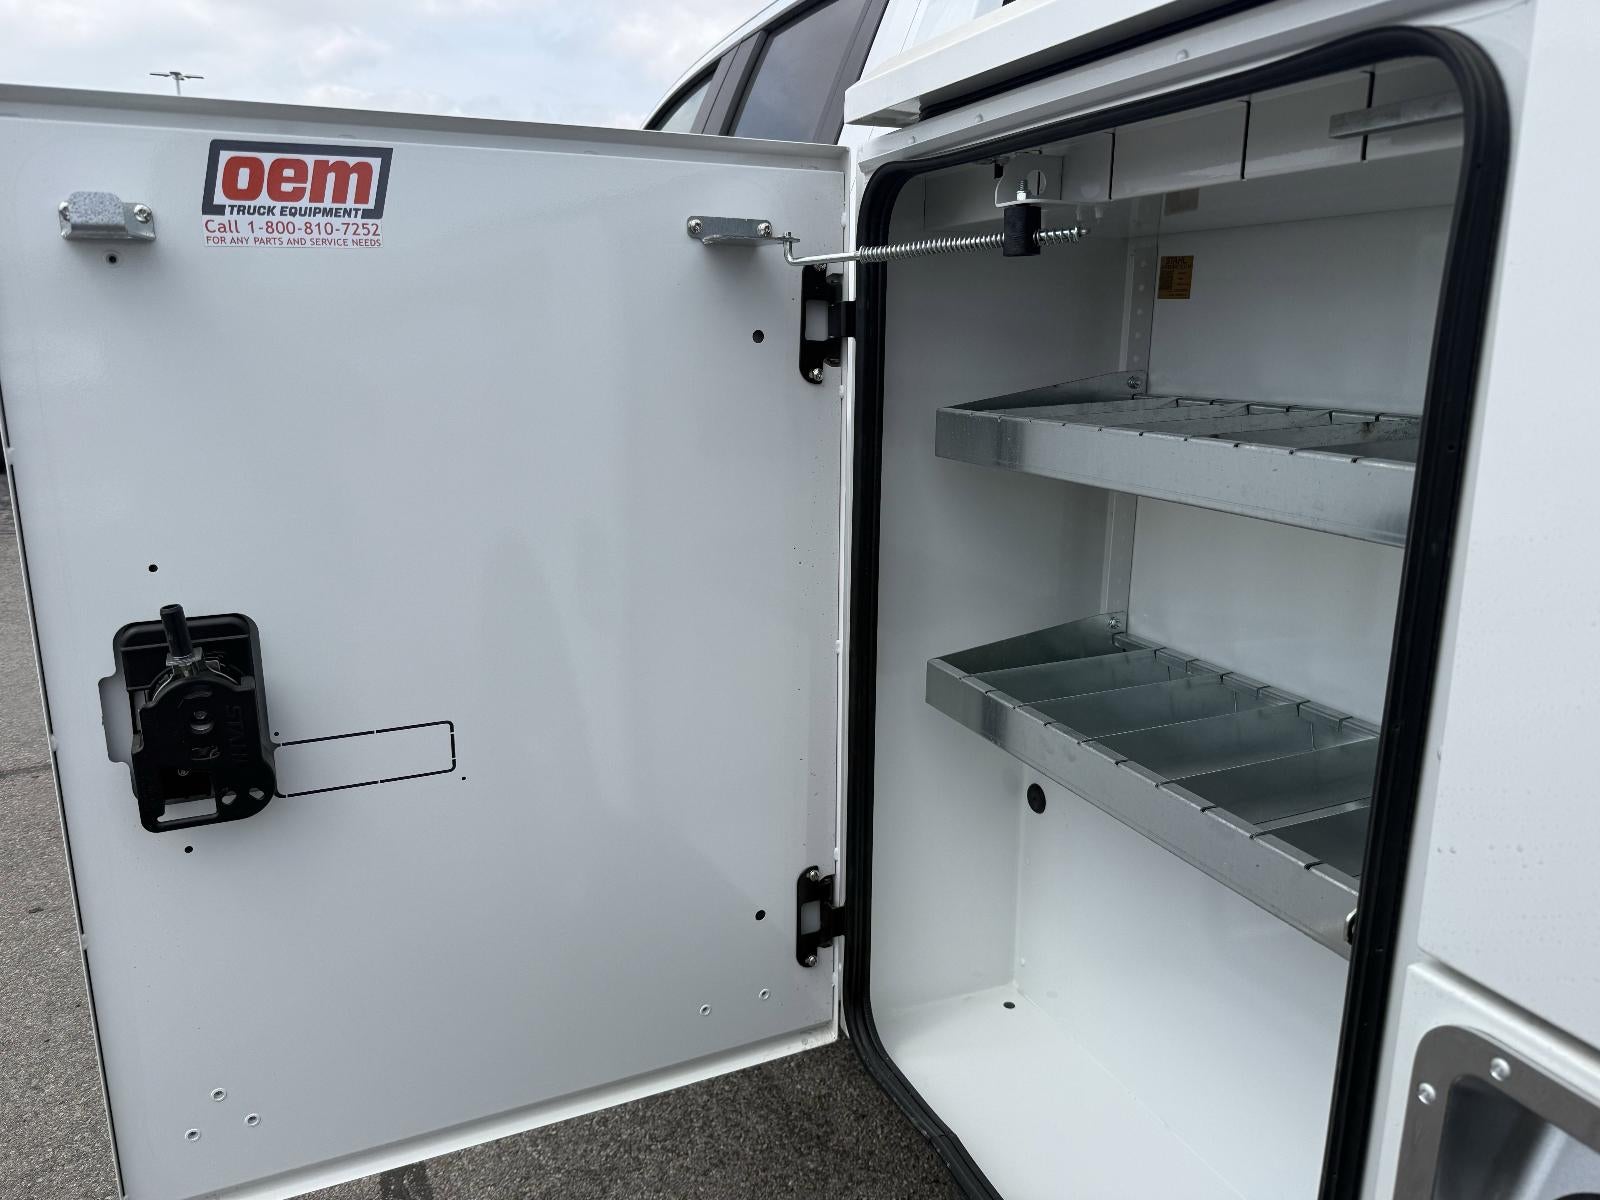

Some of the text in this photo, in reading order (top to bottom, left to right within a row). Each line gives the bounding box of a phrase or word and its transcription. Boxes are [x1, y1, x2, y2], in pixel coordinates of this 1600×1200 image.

[221, 155, 374, 205] oem
[227, 204, 363, 219] TRUCK EQUIPMENT
[204, 219, 381, 237] Call 1-800-810-7252
[206, 236, 382, 247] FOR ANY PARTS AND SERVICE NEEDS
